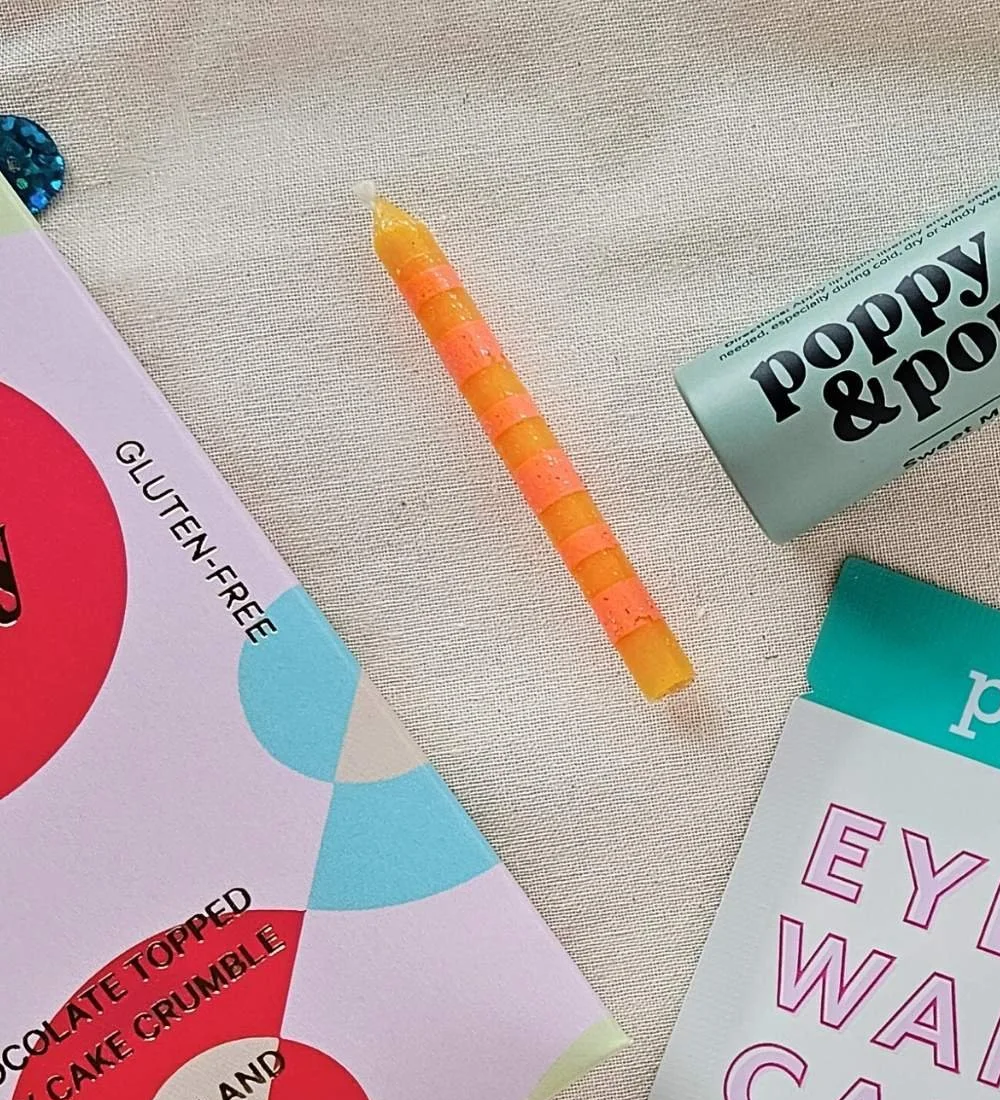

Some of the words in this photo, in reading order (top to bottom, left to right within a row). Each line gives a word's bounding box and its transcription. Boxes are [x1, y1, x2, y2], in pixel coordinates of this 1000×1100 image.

[748, 231, 990, 423] poppy
[771, 293, 829, 330] especially
[832, 268, 871, 293] during
[904, 236, 923, 251] dry
[926, 228, 939, 238] or
[941, 205, 976, 228] windy
[115, 440, 277, 643] GLUTEN-FREE
[123, 886, 252, 982] TOPPED
[133, 924, 287, 1041] CRUMBLE
